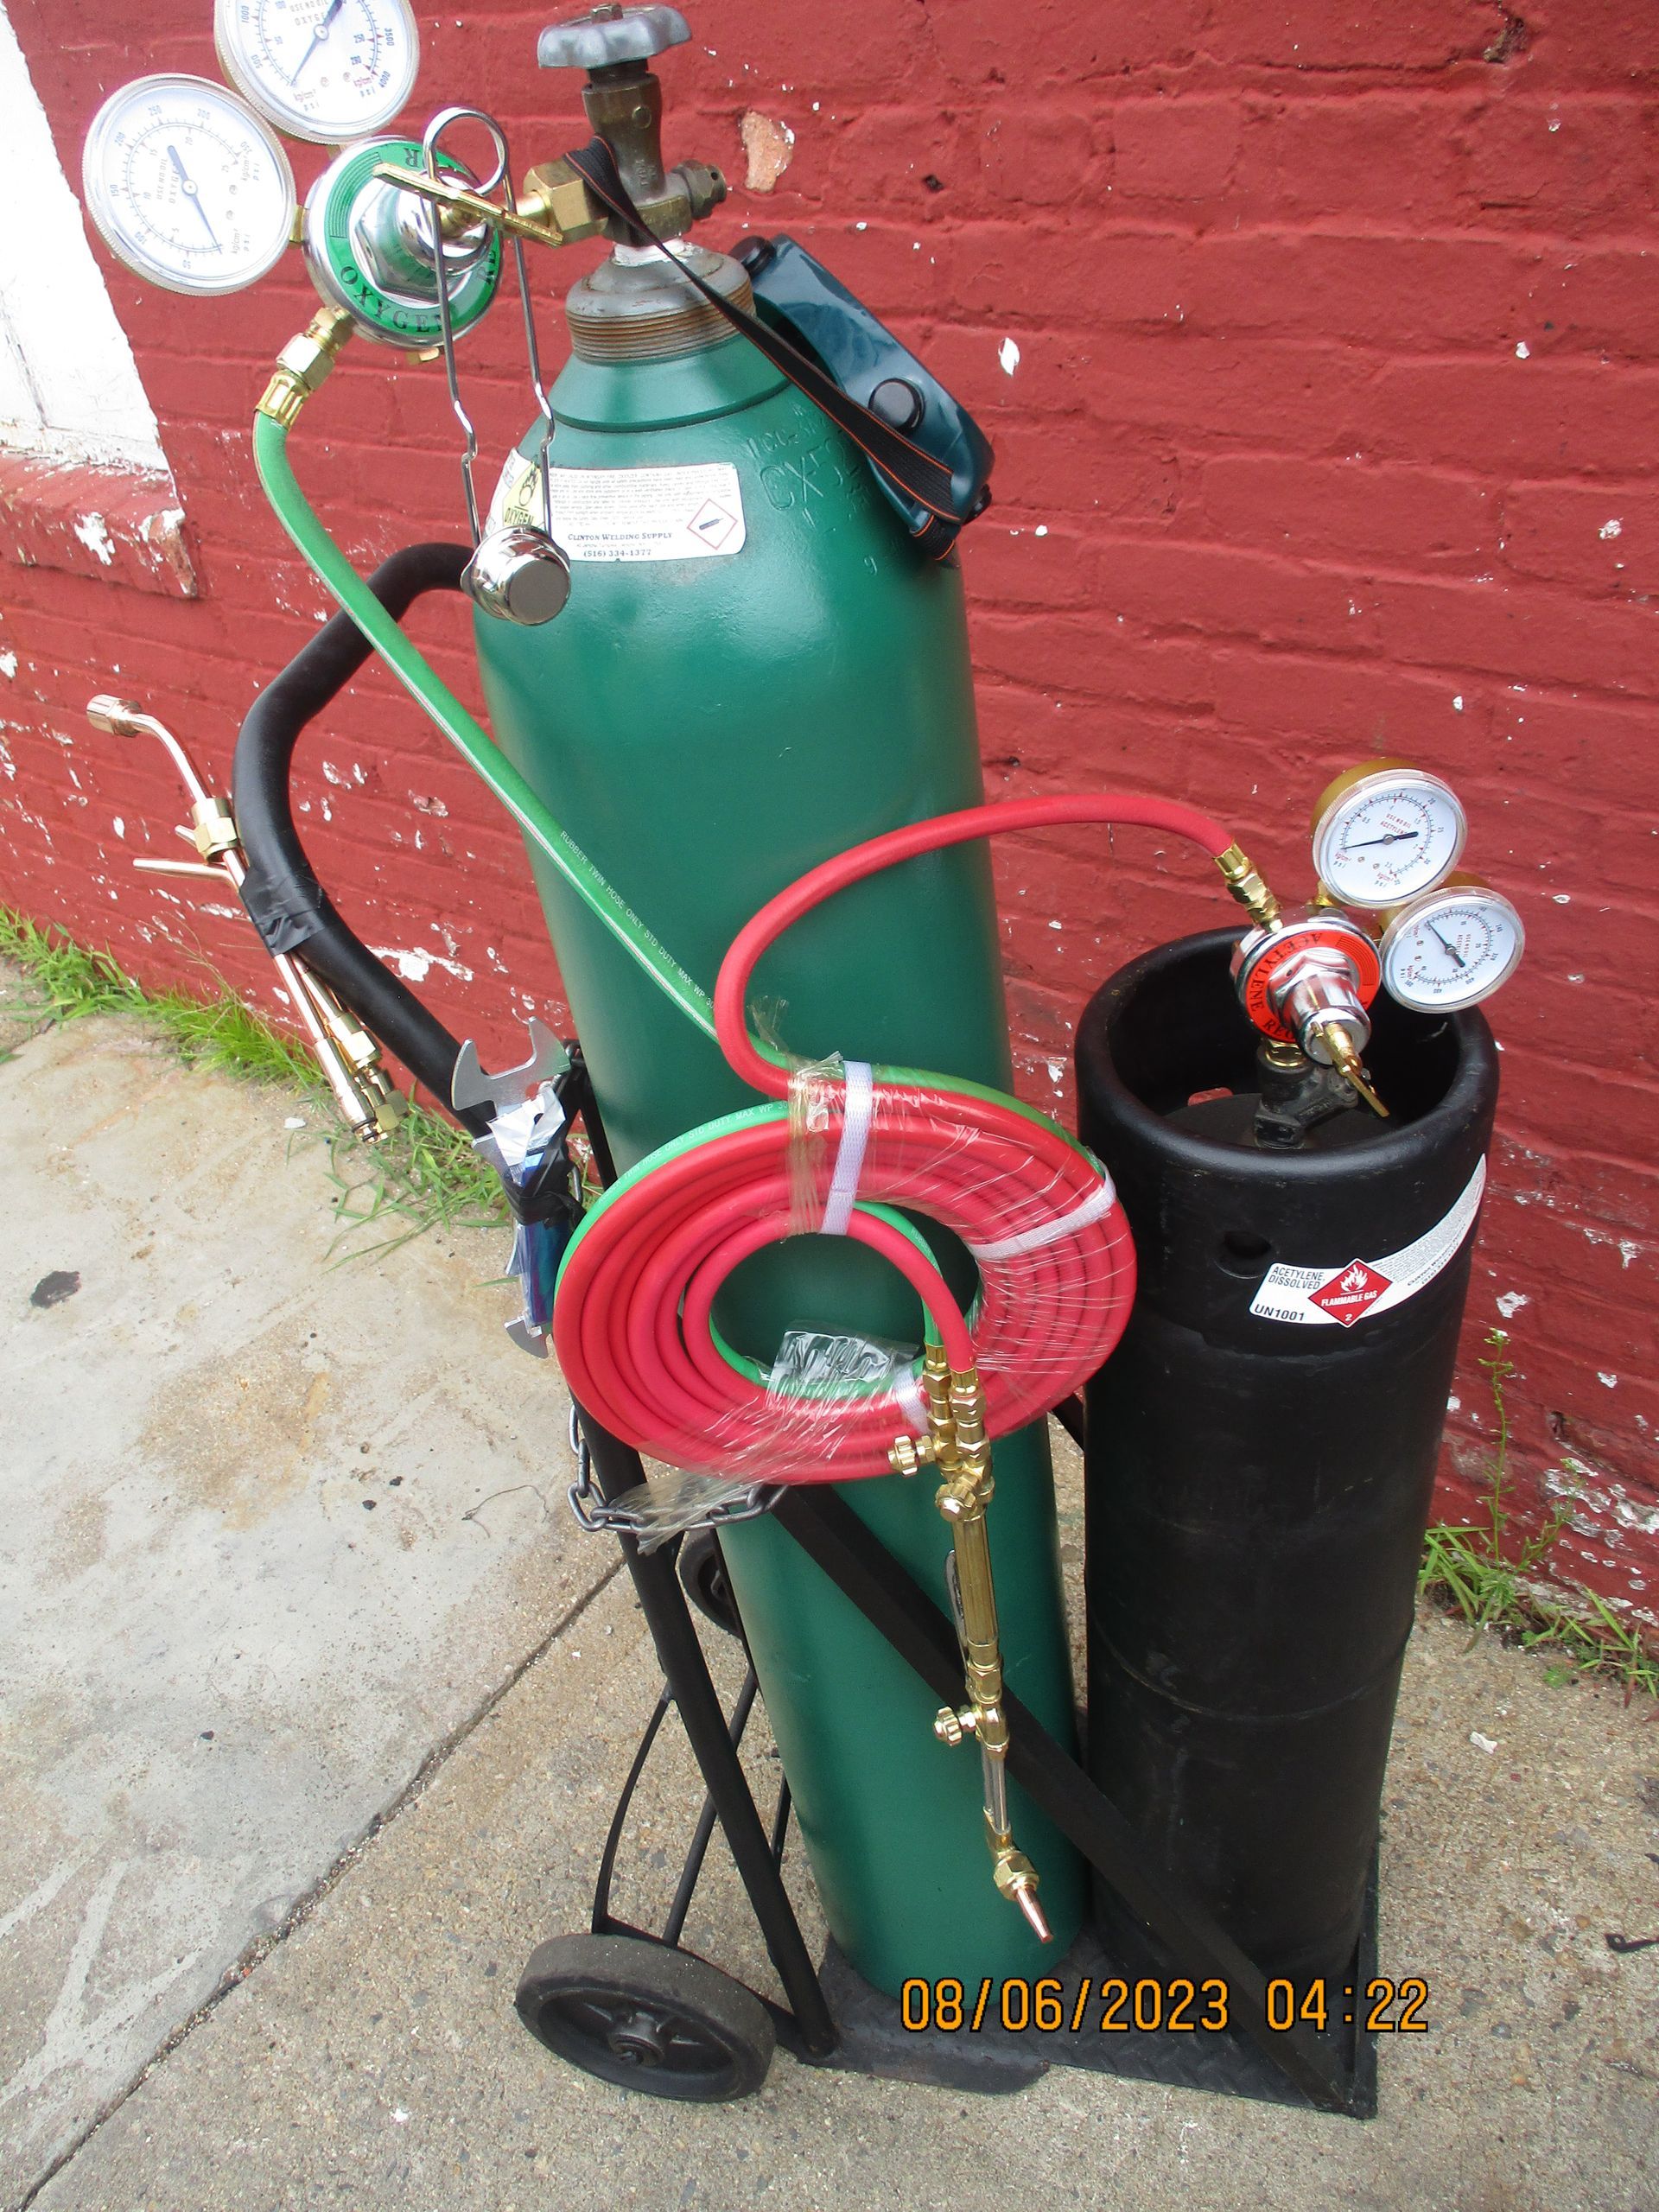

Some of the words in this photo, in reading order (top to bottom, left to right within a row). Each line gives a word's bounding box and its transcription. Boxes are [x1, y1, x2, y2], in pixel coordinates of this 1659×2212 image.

[241, 5, 250, 22] 1000
[294, 12, 325, 26] OXYGE
[385, 28, 395, 47] 3500
[251, 54, 264, 69] 500
[378, 70, 391, 88] 4000
[114, 132, 125, 146] 200
[110, 184, 119, 197] 150
[168, 168, 180, 204] OXYGE
[135, 232, 147, 245] 100
[505, 507, 534, 525] OXYGEN
[602, 532, 639, 541] WELDING
[641, 531, 673, 540] SUPPLY
[583, 549, 607, 557] (516)
[608, 549, 652, 557] 334-1377
[1380, 821, 1408, 835] ACETYLEN
[560, 830, 588, 865] RUBBER
[588, 864, 606, 887] TWIN
[606, 885, 625, 909] HOSE
[626, 908, 644, 930] ONLY
[644, 930, 658, 947] STD
[658, 946, 677, 968] DUTY
[677, 968, 693, 986] MAX
[694, 984, 705, 997] WP
[1250, 933, 1323, 1012] ACETYLENE
[664, 1135, 685, 1152] ONLY
[689, 1127, 705, 1139] STD
[709, 1115, 734, 1131] DUTY
[735, 1108, 754, 1121] MAX
[759, 1103, 773, 1114] WP
[1268, 1274, 1320, 1290] DISSOLVED
[1273, 1267, 1325, 1281] ACETYLENE,
[1321, 1294, 1363, 1306] FLAMMABLE
[1364, 1290, 1377, 1300] GAS
[1255, 1304, 1305, 1321] UN1001
